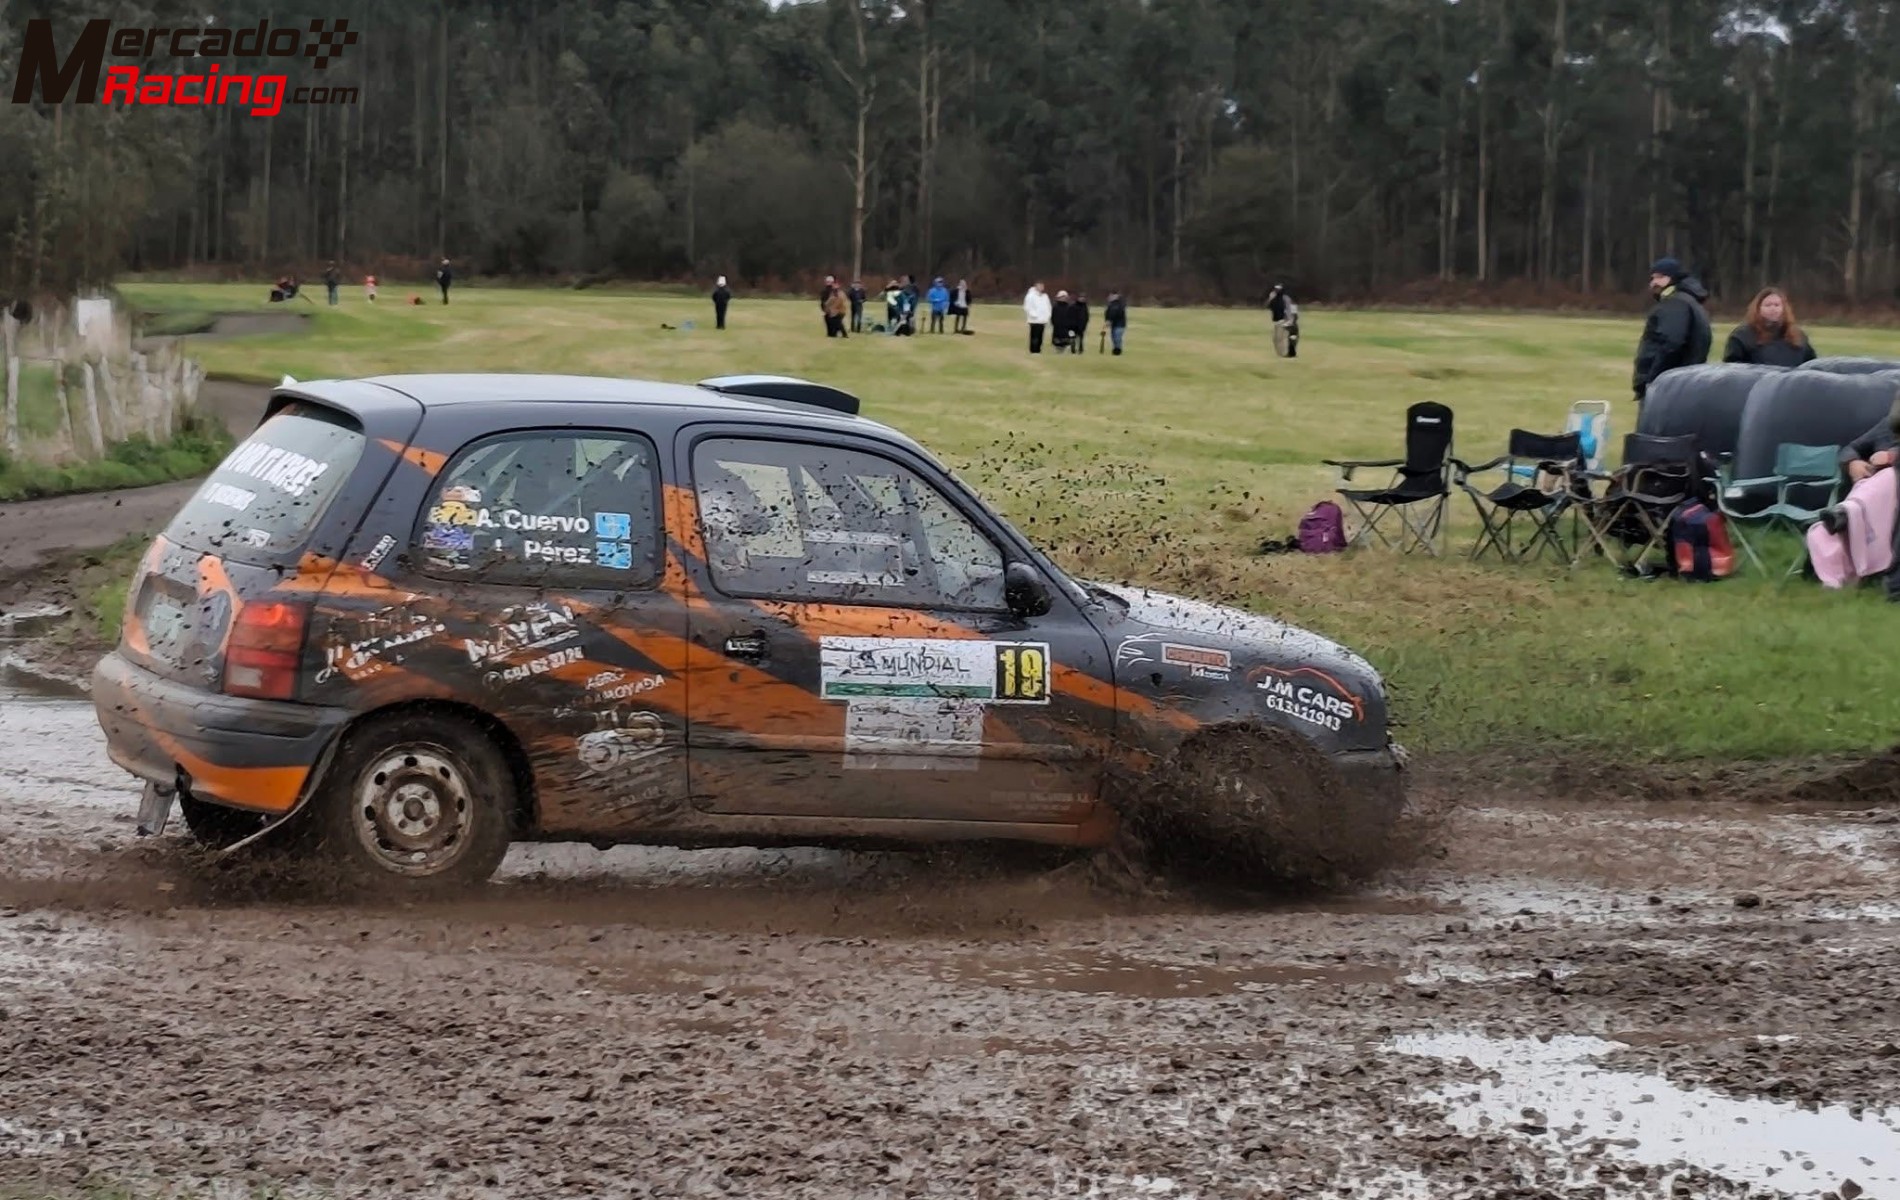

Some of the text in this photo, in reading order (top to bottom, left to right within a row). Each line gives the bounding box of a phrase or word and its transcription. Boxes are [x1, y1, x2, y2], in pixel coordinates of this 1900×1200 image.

[475, 508, 501, 528] A.
[503, 509, 590, 533] Cuervo
[524, 540, 592, 564] Pérez
[880, 651, 971, 673] MUNDIAL
[1000, 649, 1044, 697] 19
[1297, 687, 1355, 718] CARS
